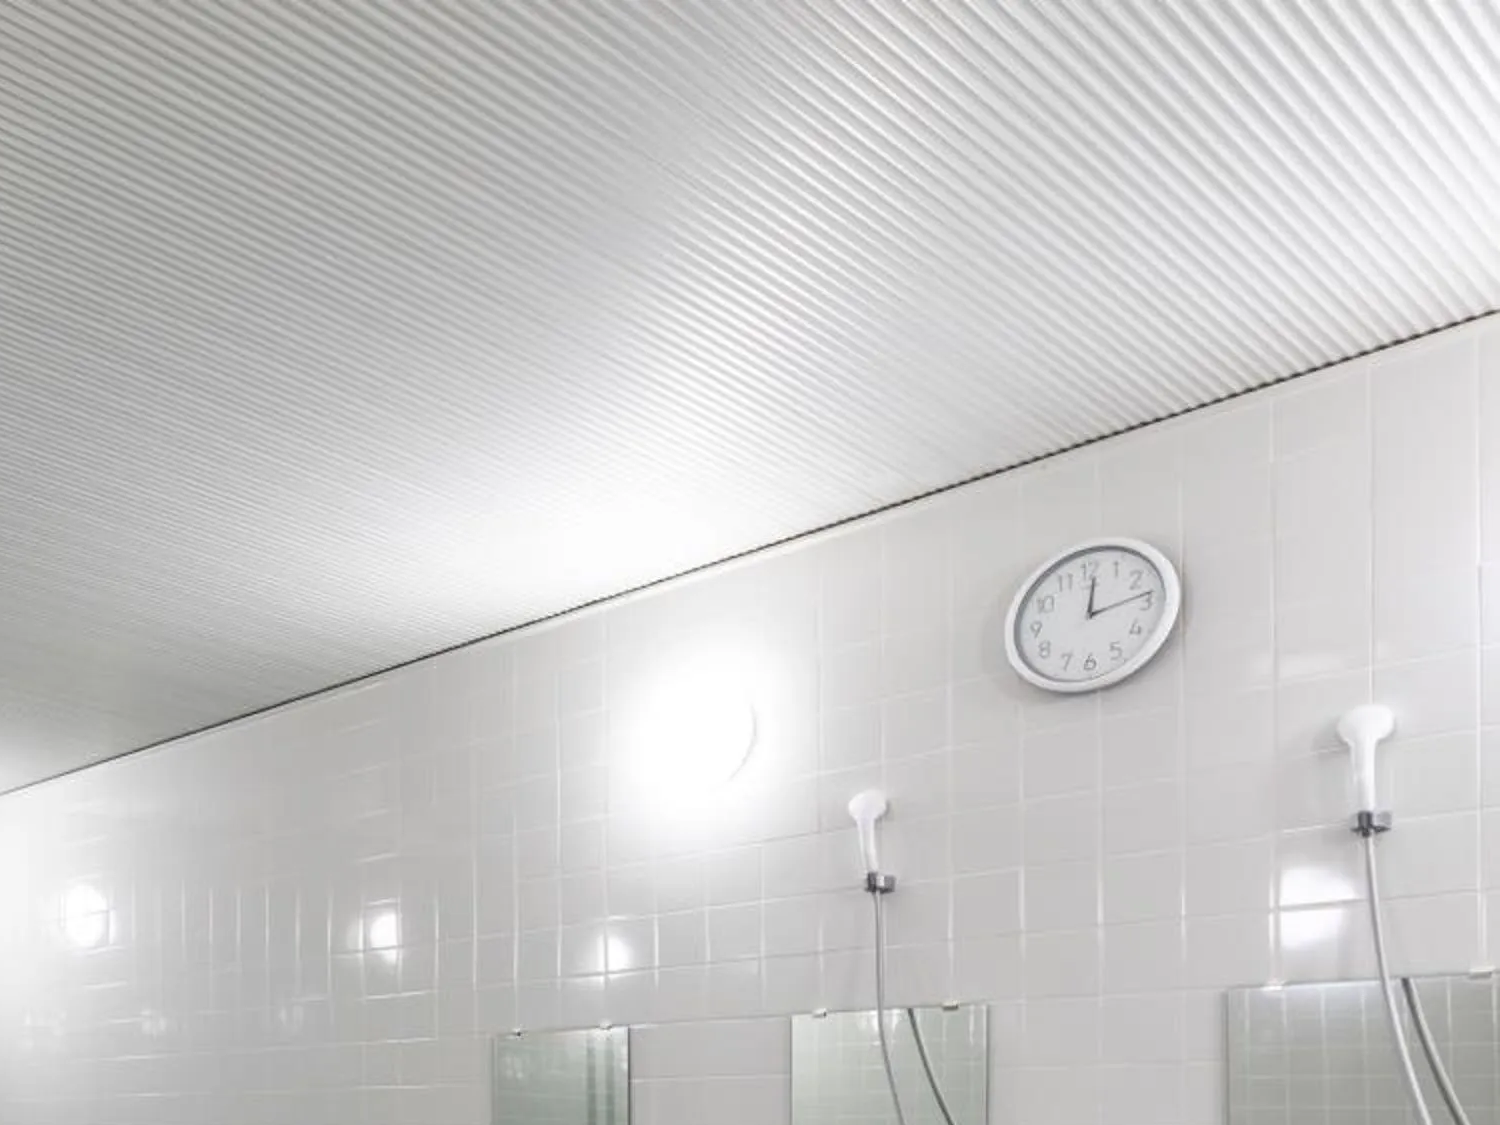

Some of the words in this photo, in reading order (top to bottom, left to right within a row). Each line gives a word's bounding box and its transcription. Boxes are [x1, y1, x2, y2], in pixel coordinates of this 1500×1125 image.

[1058, 573, 1074, 592] 11
[1129, 569, 1143, 590] 2
[1037, 595, 1055, 613] 10
[1139, 592, 1152, 611] 3
[1030, 620, 1042, 638] 9
[1129, 618, 1142, 635] 4
[1038, 641, 1051, 659] 8
[1109, 641, 1122, 660] 5
[1061, 652, 1074, 670] 7
[1083, 652, 1097, 670] 6
